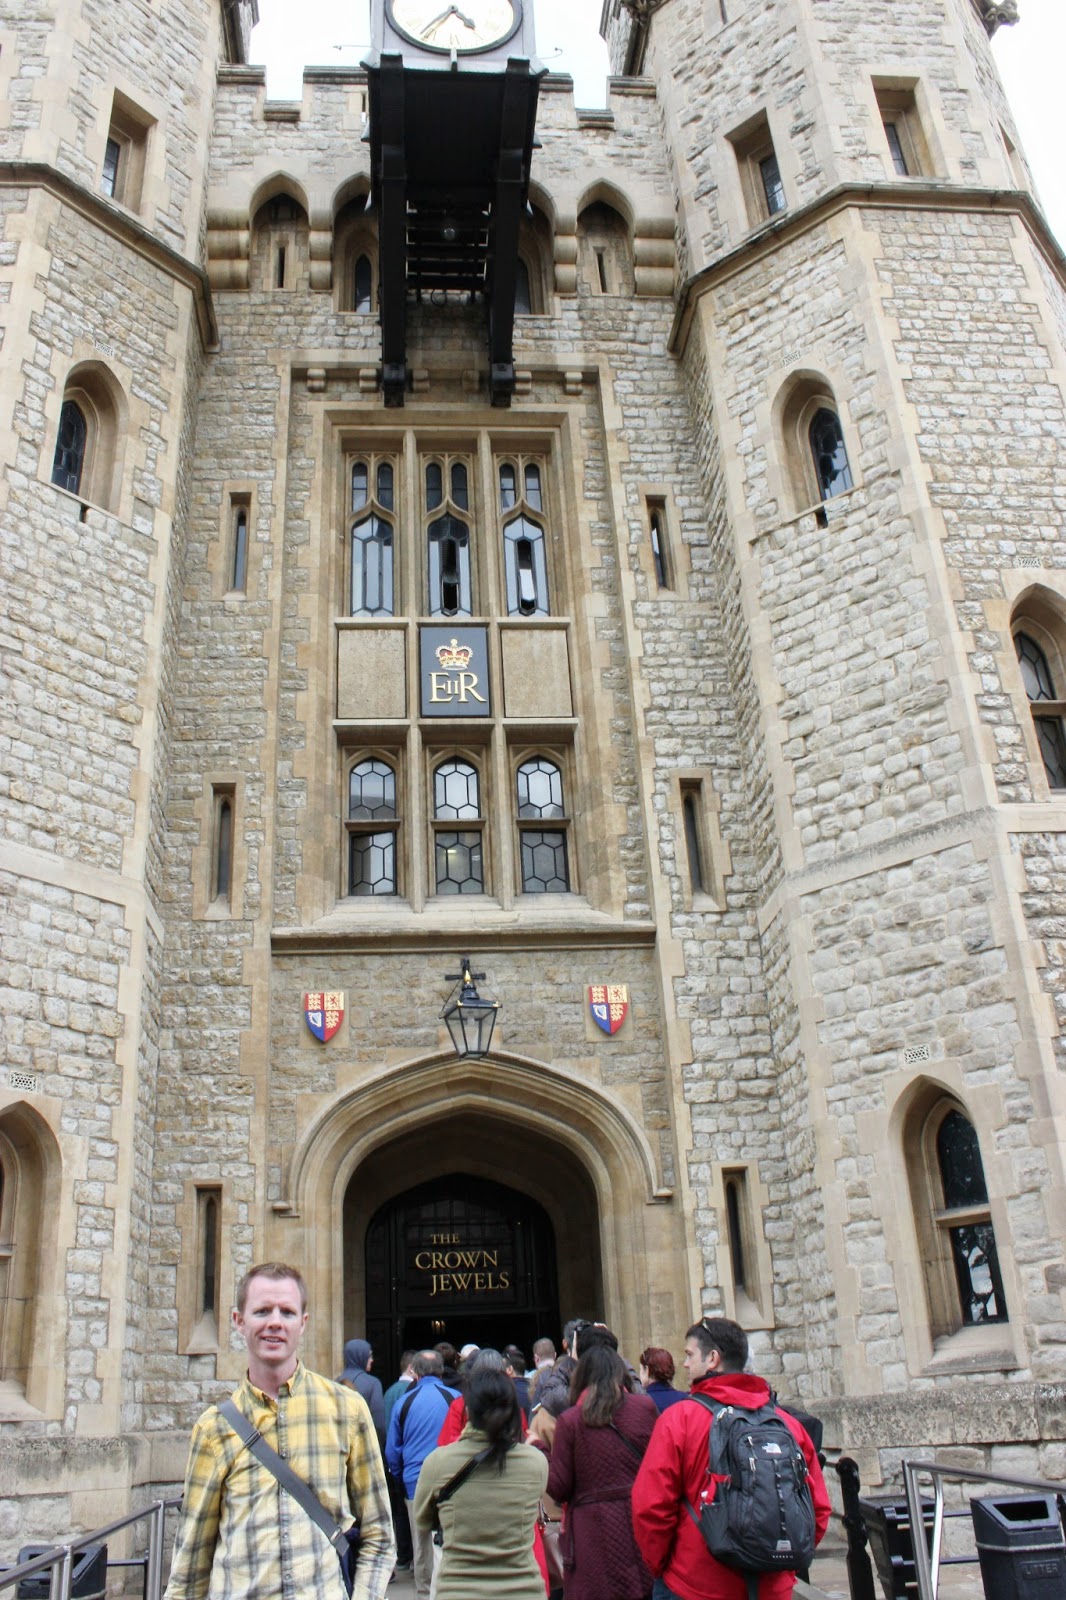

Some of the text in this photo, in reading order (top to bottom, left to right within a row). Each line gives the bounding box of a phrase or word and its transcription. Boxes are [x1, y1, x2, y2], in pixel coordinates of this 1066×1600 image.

[430, 1233, 460, 1244] THE
[415, 1251, 498, 1269] CROWN
[430, 1271, 510, 1296] JEWELS
[1024, 1563, 1059, 1575] LITTER
